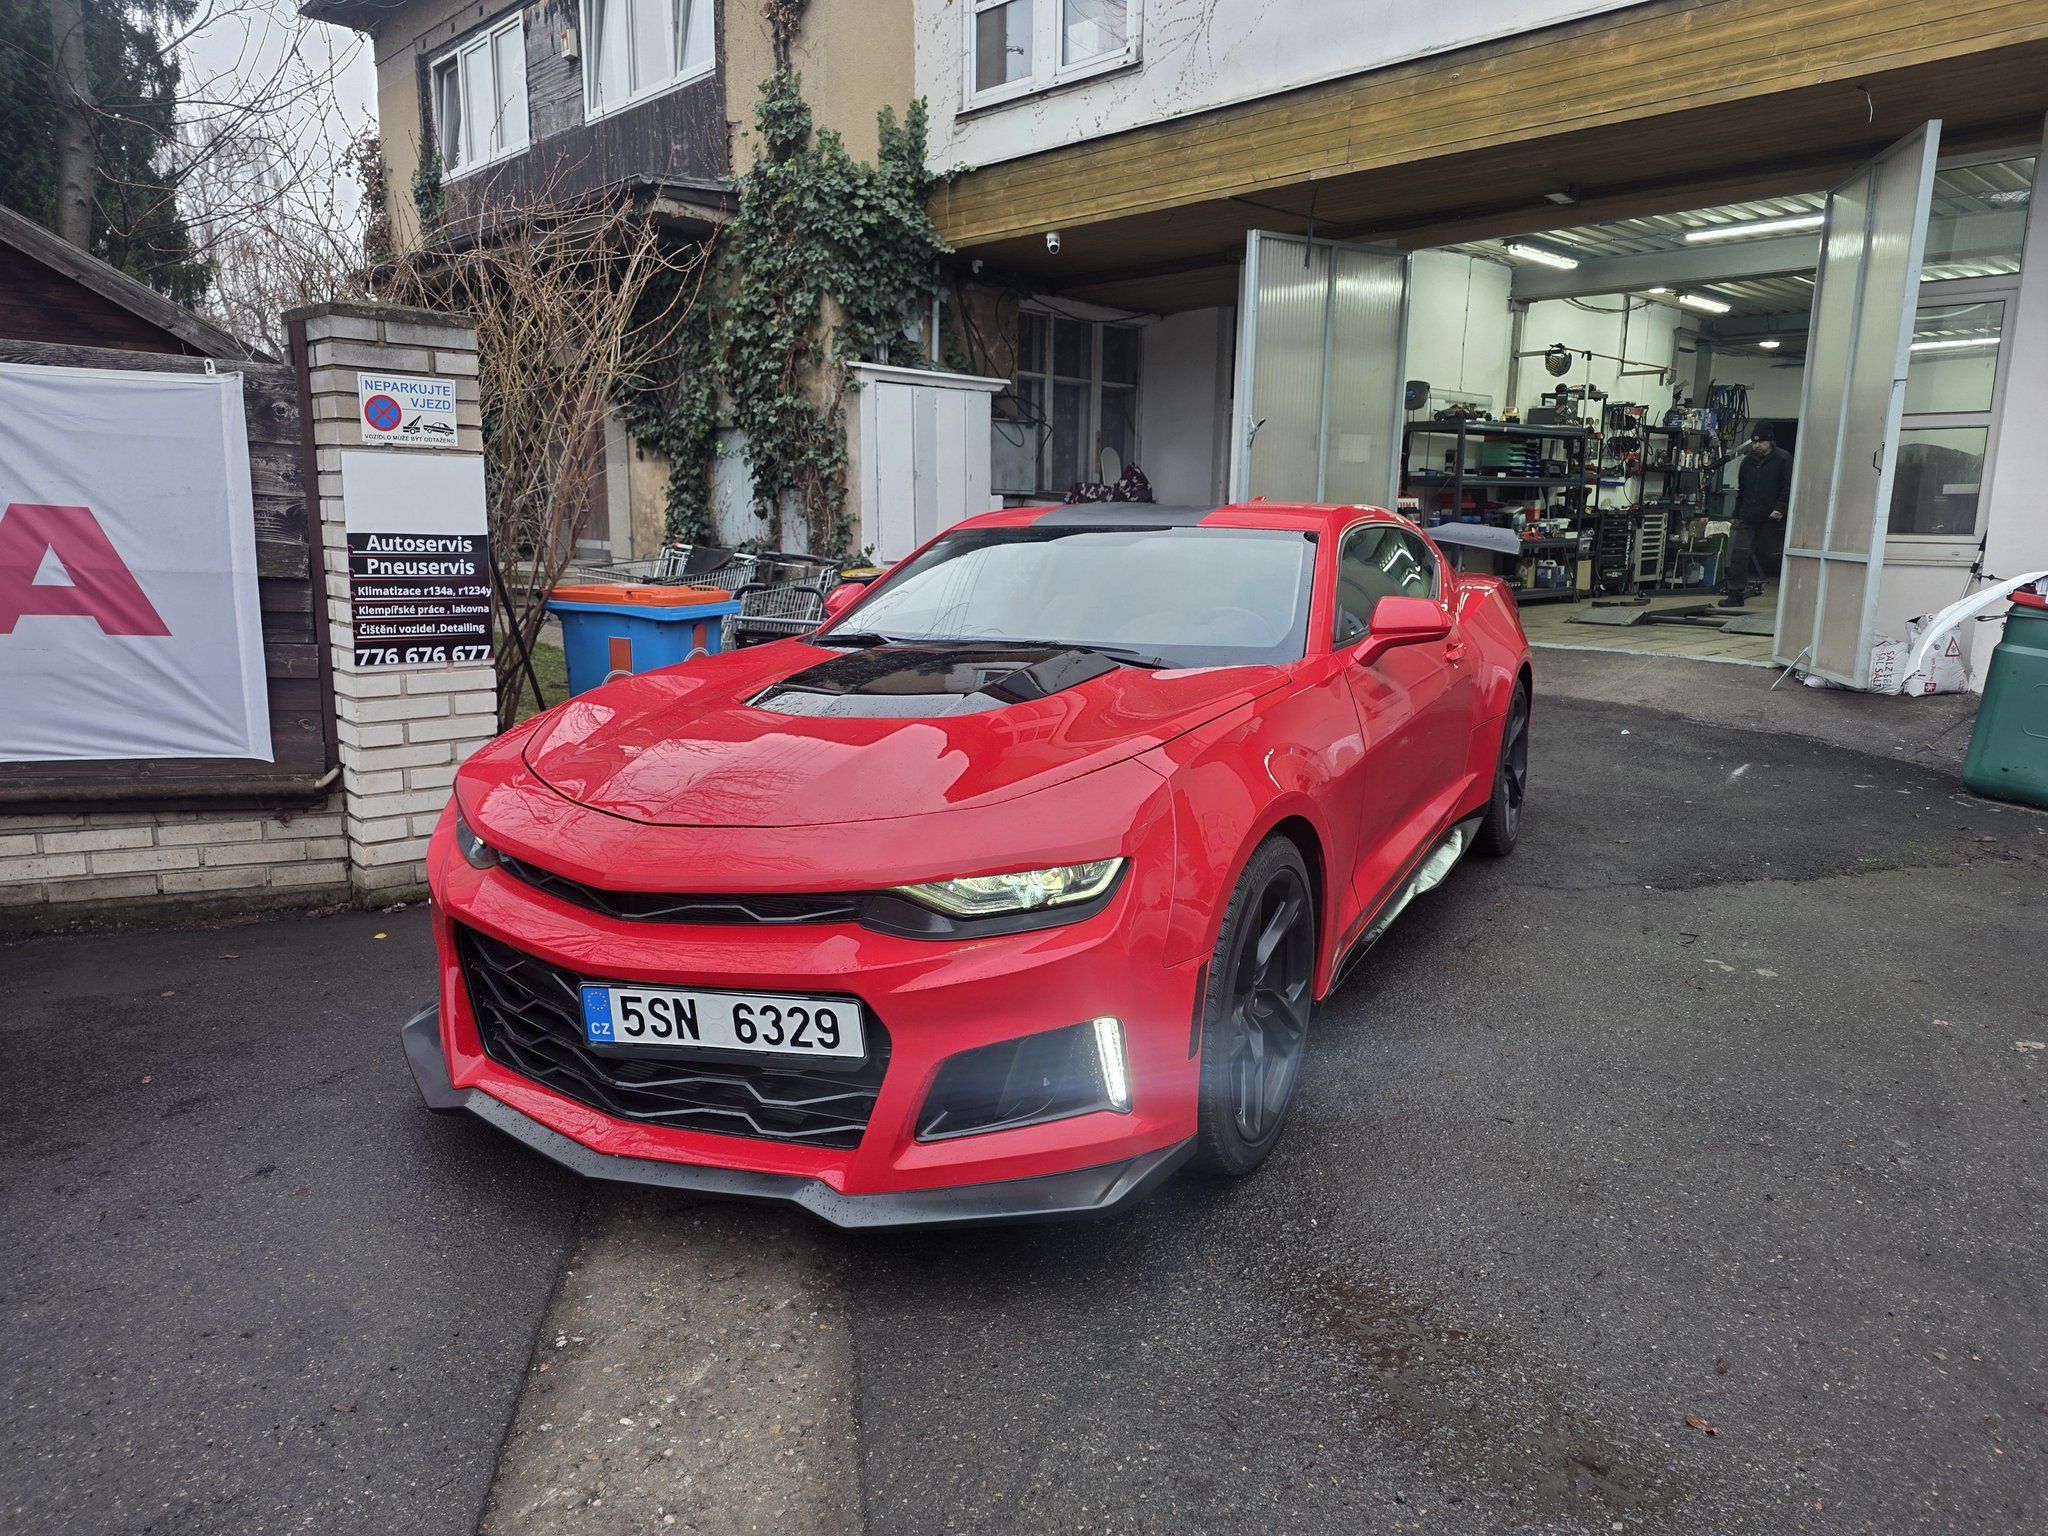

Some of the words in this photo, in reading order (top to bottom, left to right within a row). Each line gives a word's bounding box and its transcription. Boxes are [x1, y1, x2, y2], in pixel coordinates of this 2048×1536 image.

[364, 379, 451, 396] NEPARKUJTE
[410, 397, 451, 410] VJEZD
[410, 434, 422, 442] BÝT
[423, 436, 456, 444] ODTAŽENO
[366, 534, 473, 552] Autoservis
[366, 558, 475, 575] Pneuservis
[357, 586, 421, 596] Klimatizace
[423, 586, 456, 597] r134a,
[358, 605, 416, 616] Klempířské
[417, 604, 445, 616] práce
[452, 604, 490, 613] lakovna
[359, 623, 397, 635] Čištění
[398, 624, 435, 634] vozidel
[356, 648, 399, 666] 776
[405, 646, 447, 664] 676
[452, 644, 491, 662] 677
[1884, 650, 1895, 672] SALZ
[1872, 668, 1884, 688] SALT
[590, 1021, 611, 1036] CZ
[619, 995, 701, 1041] 5SN
[731, 1002, 841, 1050] 6329
